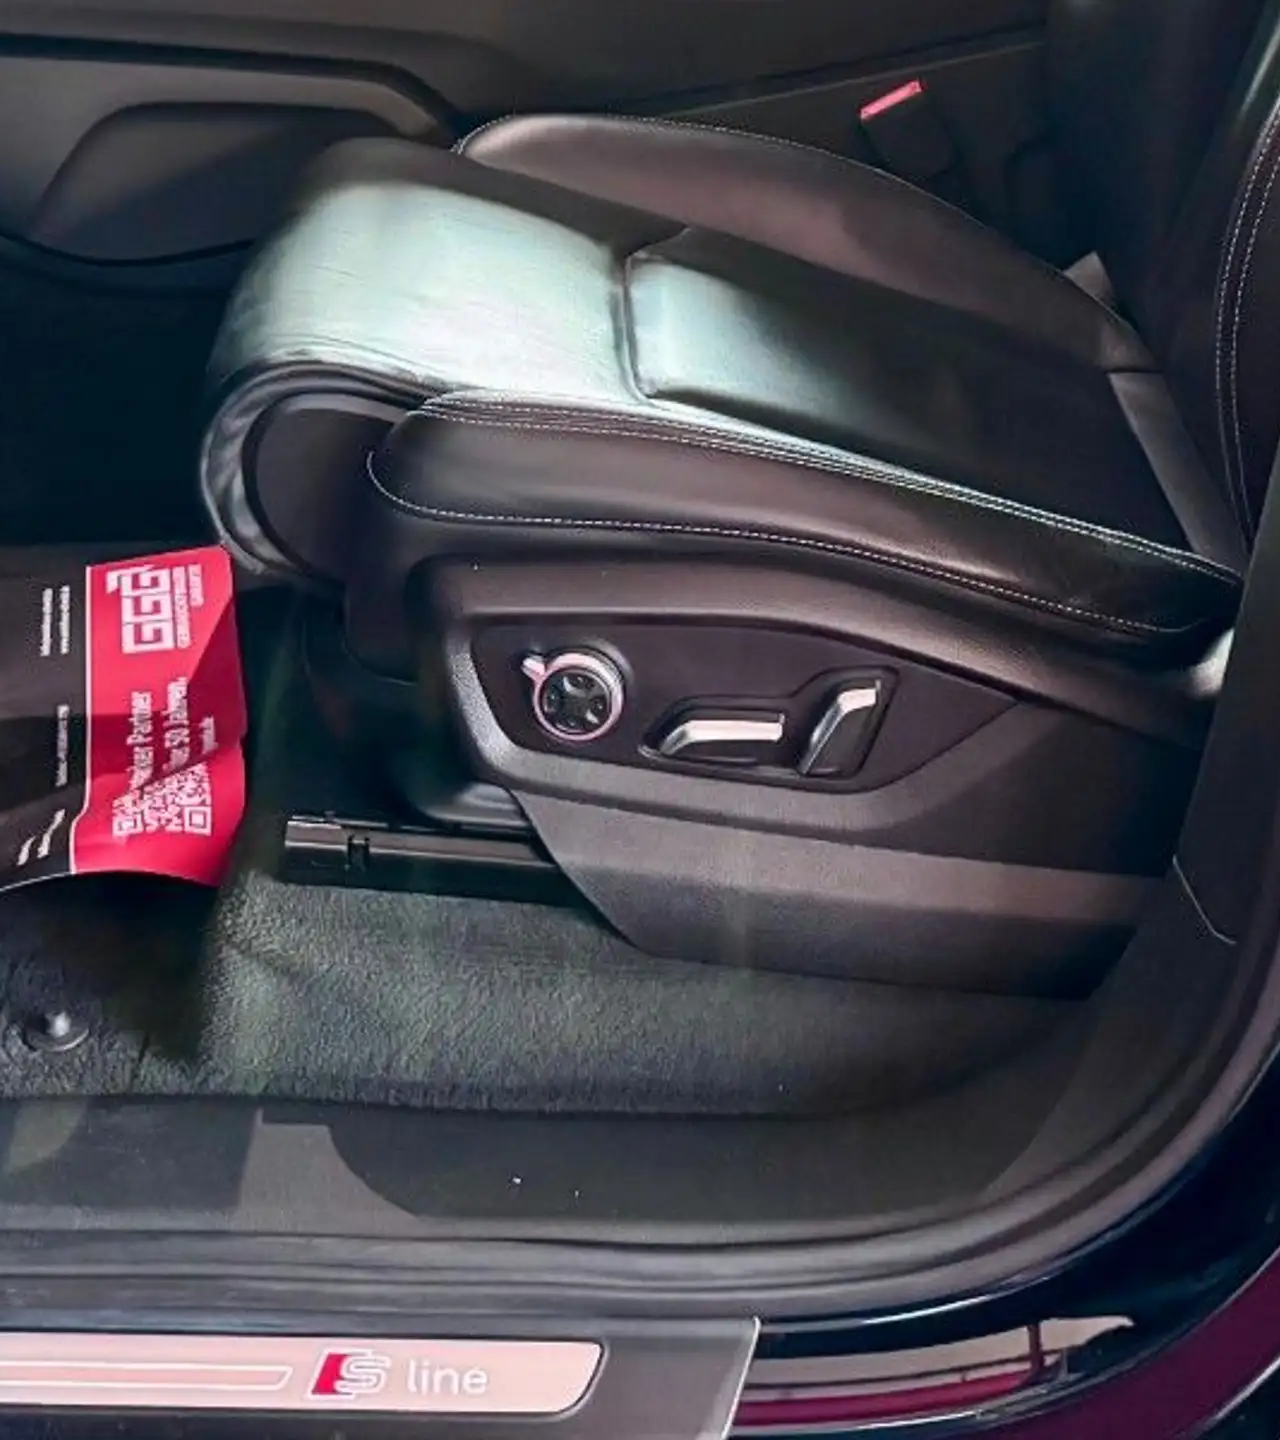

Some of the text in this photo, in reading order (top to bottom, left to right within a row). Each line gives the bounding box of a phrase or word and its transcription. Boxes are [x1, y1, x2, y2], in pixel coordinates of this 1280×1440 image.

[120, 567, 175, 654] GGG
[324, 1350, 488, 1397] S line
